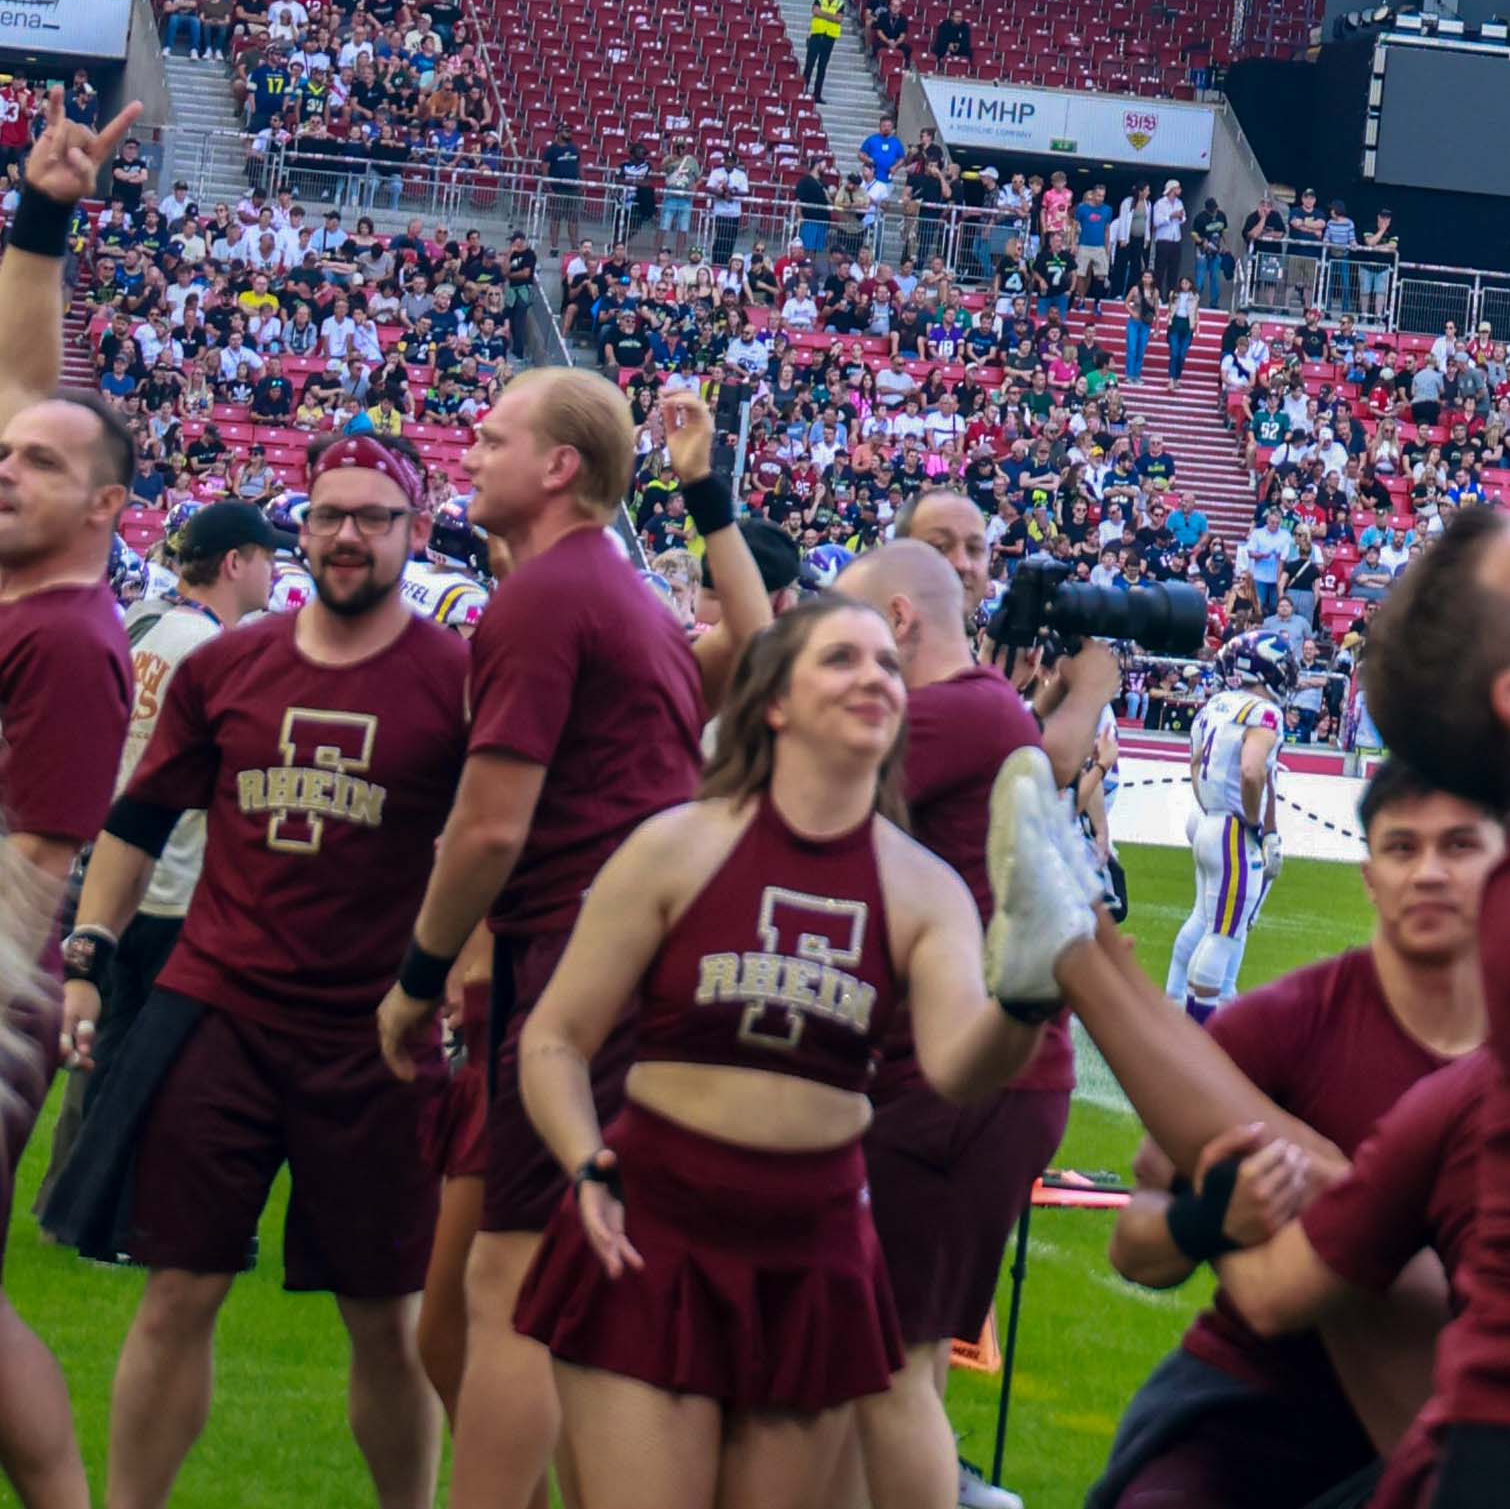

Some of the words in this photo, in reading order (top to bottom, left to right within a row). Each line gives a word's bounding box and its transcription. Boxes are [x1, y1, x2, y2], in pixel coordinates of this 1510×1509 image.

[267, 77, 284, 94] 17
[978, 99, 1035, 124] MHP
[1006, 274, 1023, 290] 4
[1048, 267, 1064, 286] 7
[938, 340, 954, 356] 18
[237, 767, 387, 827] RHEIN
